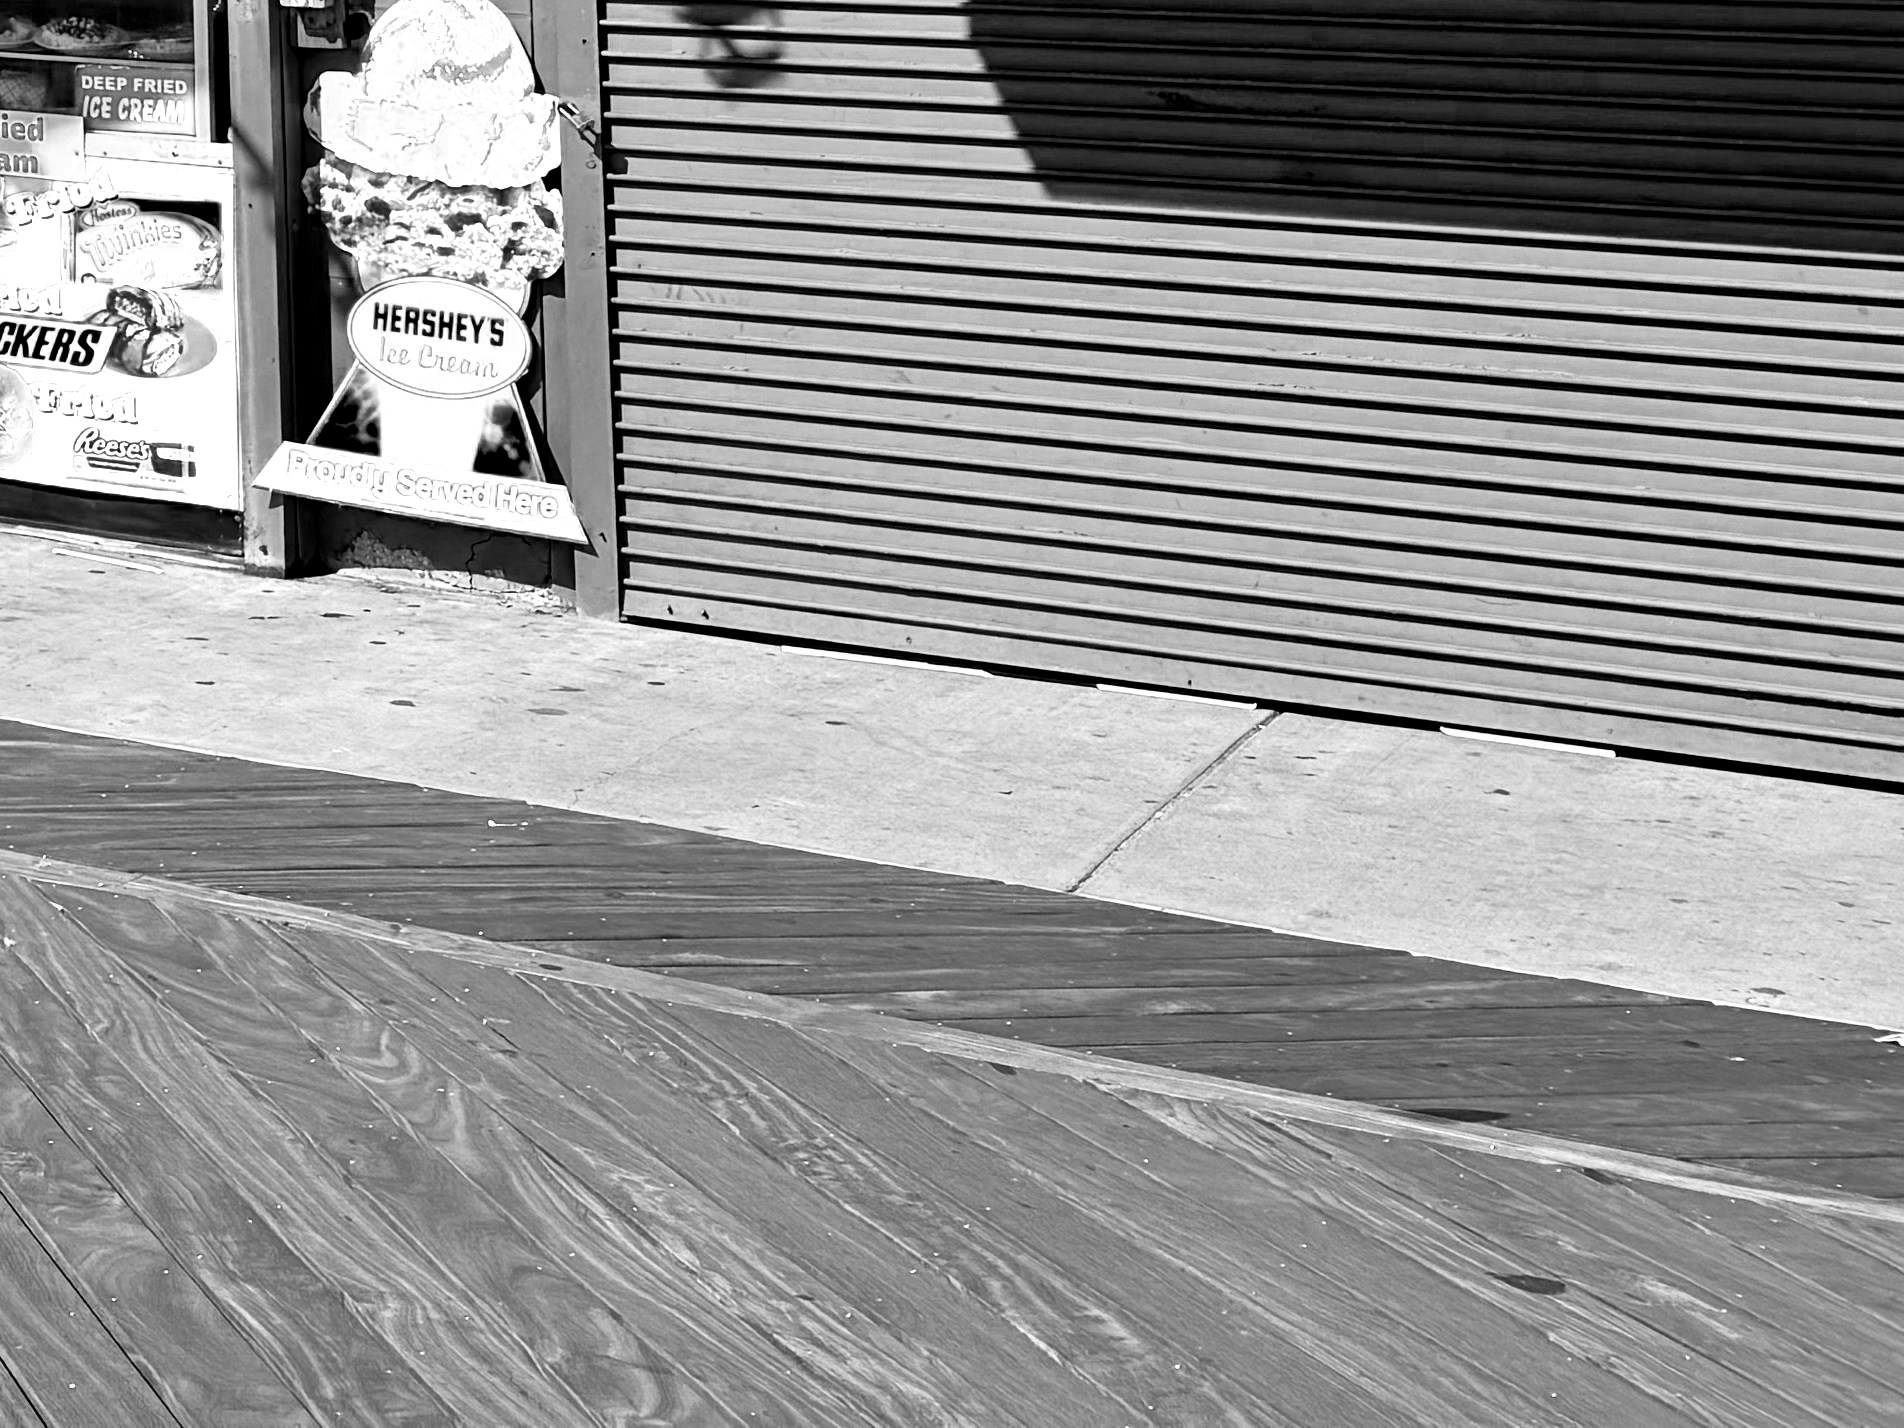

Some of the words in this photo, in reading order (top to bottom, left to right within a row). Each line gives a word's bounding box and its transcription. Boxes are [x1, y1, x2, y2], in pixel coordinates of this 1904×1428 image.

[80, 74, 129, 93] DEEP
[133, 76, 187, 95] FRIED
[82, 96, 108, 118] ICE
[113, 96, 186, 125] CREAM
[372, 300, 505, 347] HERSHEY'S
[378, 336, 414, 365] Ice
[417, 345, 499, 380] Cream
